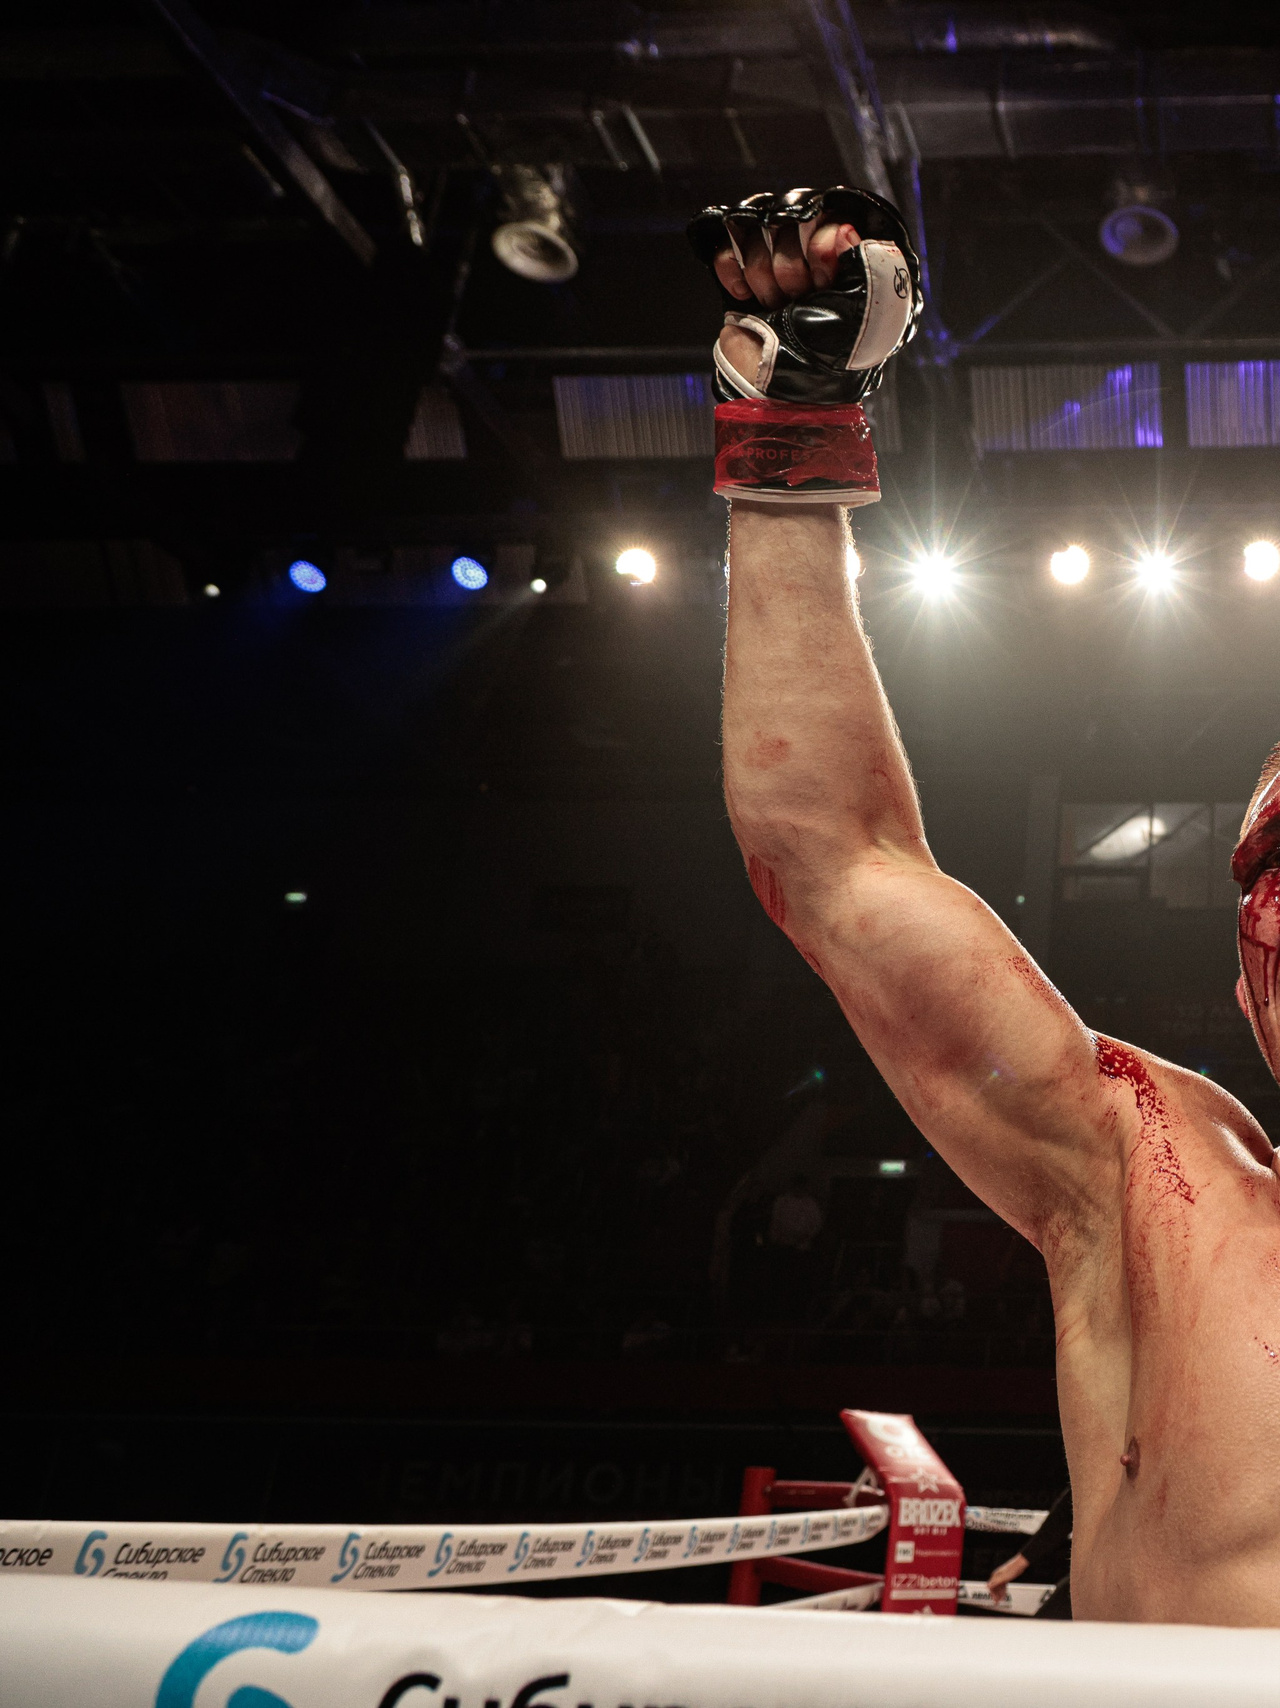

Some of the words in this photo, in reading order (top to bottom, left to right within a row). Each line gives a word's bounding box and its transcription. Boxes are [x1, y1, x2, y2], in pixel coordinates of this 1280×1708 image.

[113, 1541, 206, 1566] Сибирское
[251, 1542, 327, 1565] Сибирское
[365, 1541, 426, 1562] Сибирское
[456, 1539, 508, 1559] Сибирское
[533, 1537, 576, 1555] Сибирское
[353, 1562, 401, 1580] Стекло
[446, 1558, 487, 1575] Стекло
[522, 1555, 558, 1570] Стекло
[239, 1565, 296, 1583] Стекло
